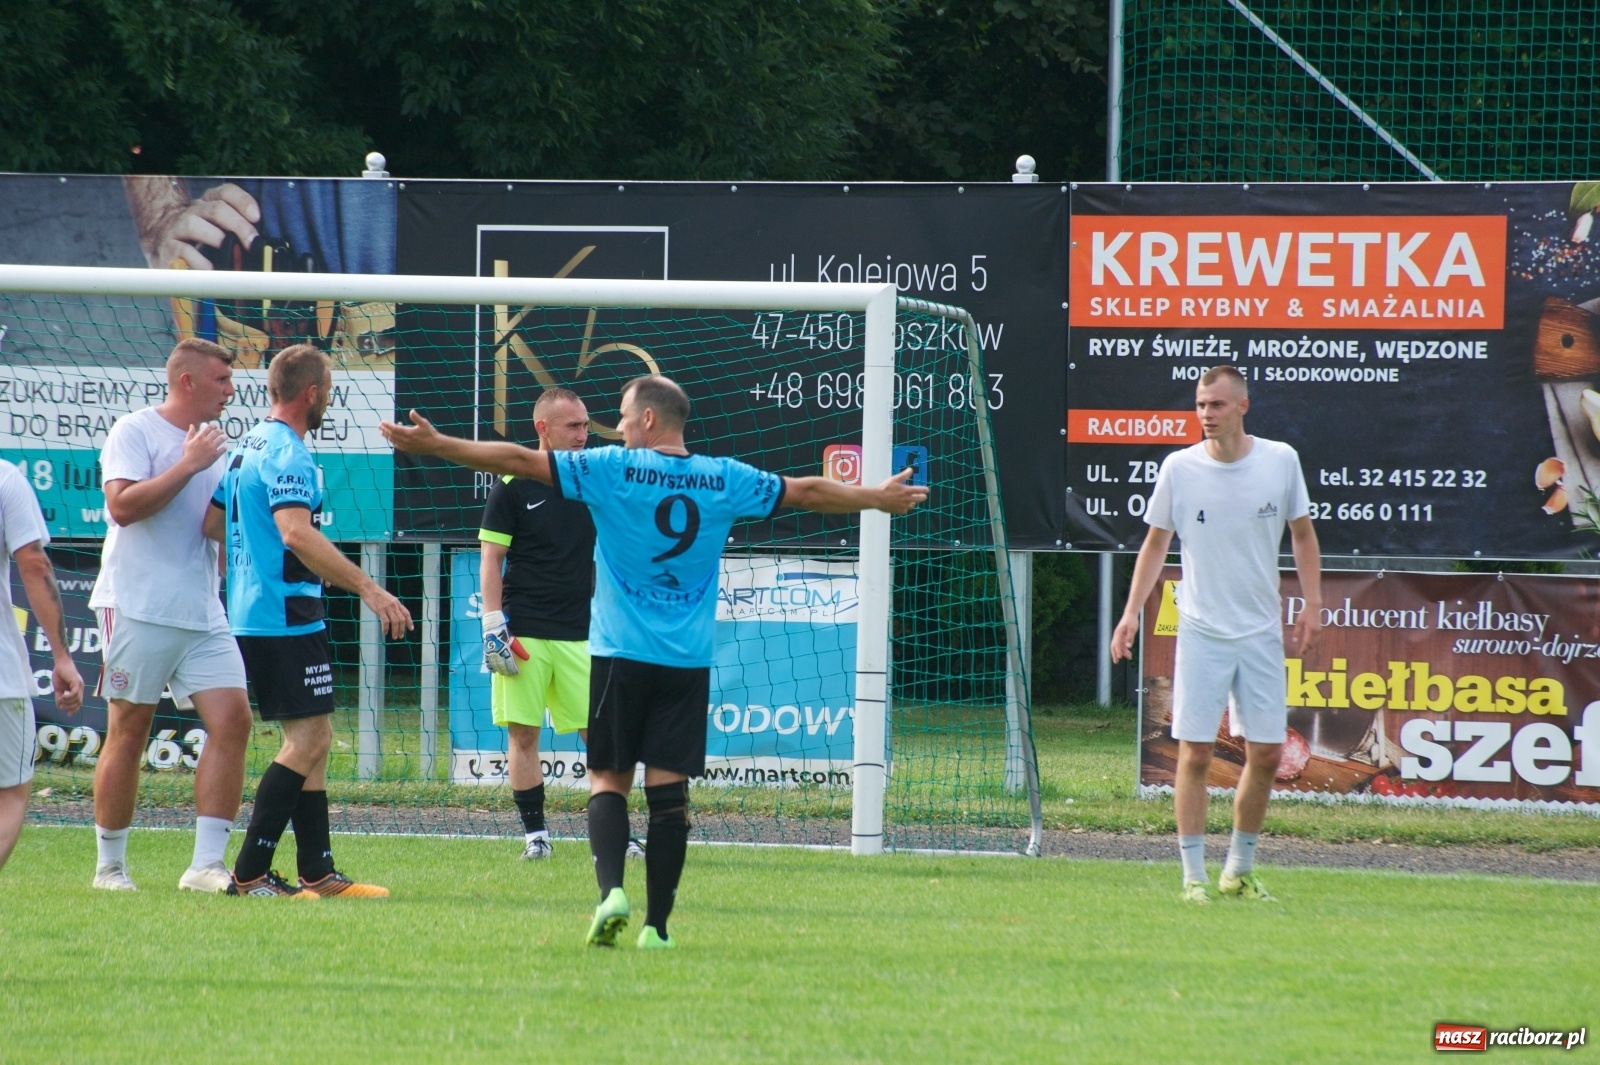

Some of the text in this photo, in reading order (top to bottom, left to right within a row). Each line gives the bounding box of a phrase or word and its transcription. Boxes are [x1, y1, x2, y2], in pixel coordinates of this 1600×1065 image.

[817, 253, 957, 292] Kolejowa
[970, 254, 988, 292] 5
[1091, 231, 1486, 288] KREWETKA
[1090, 292, 1486, 319] SKLEP RYBNY & SMAŻALNIA
[751, 313, 853, 351] 47-450
[1088, 333, 1489, 363] RYBY ŚWIEŻE, MROŻONE, WĘDZONE
[1253, 367, 1259, 381] I
[1264, 365, 1400, 383] SŁODKOWODNE
[750, 372, 803, 409] +48
[11, 414, 48, 437] DO
[1087, 413, 1188, 437] RACIBÓRZ
[625, 466, 726, 492] RUDYSZWAŁD
[1086, 464, 1119, 483] UL.
[1319, 466, 1355, 487] tel.
[1358, 468, 1384, 487] 32
[1388, 469, 1426, 488] 415
[1431, 469, 1457, 488] 22
[1461, 469, 1488, 488] 32
[1085, 497, 1118, 516] UL.
[1308, 502, 1332, 520] 32
[1337, 502, 1375, 521] 666
[1379, 503, 1392, 521] 0
[1397, 503, 1433, 522] 111
[1196, 509, 1206, 525] 4
[651, 493, 701, 563] 9
[1285, 596, 1551, 642] Poducent kiełbasy
[1451, 633, 1600, 665] surowo-dojrz
[1284, 657, 1568, 717] kiełbasa
